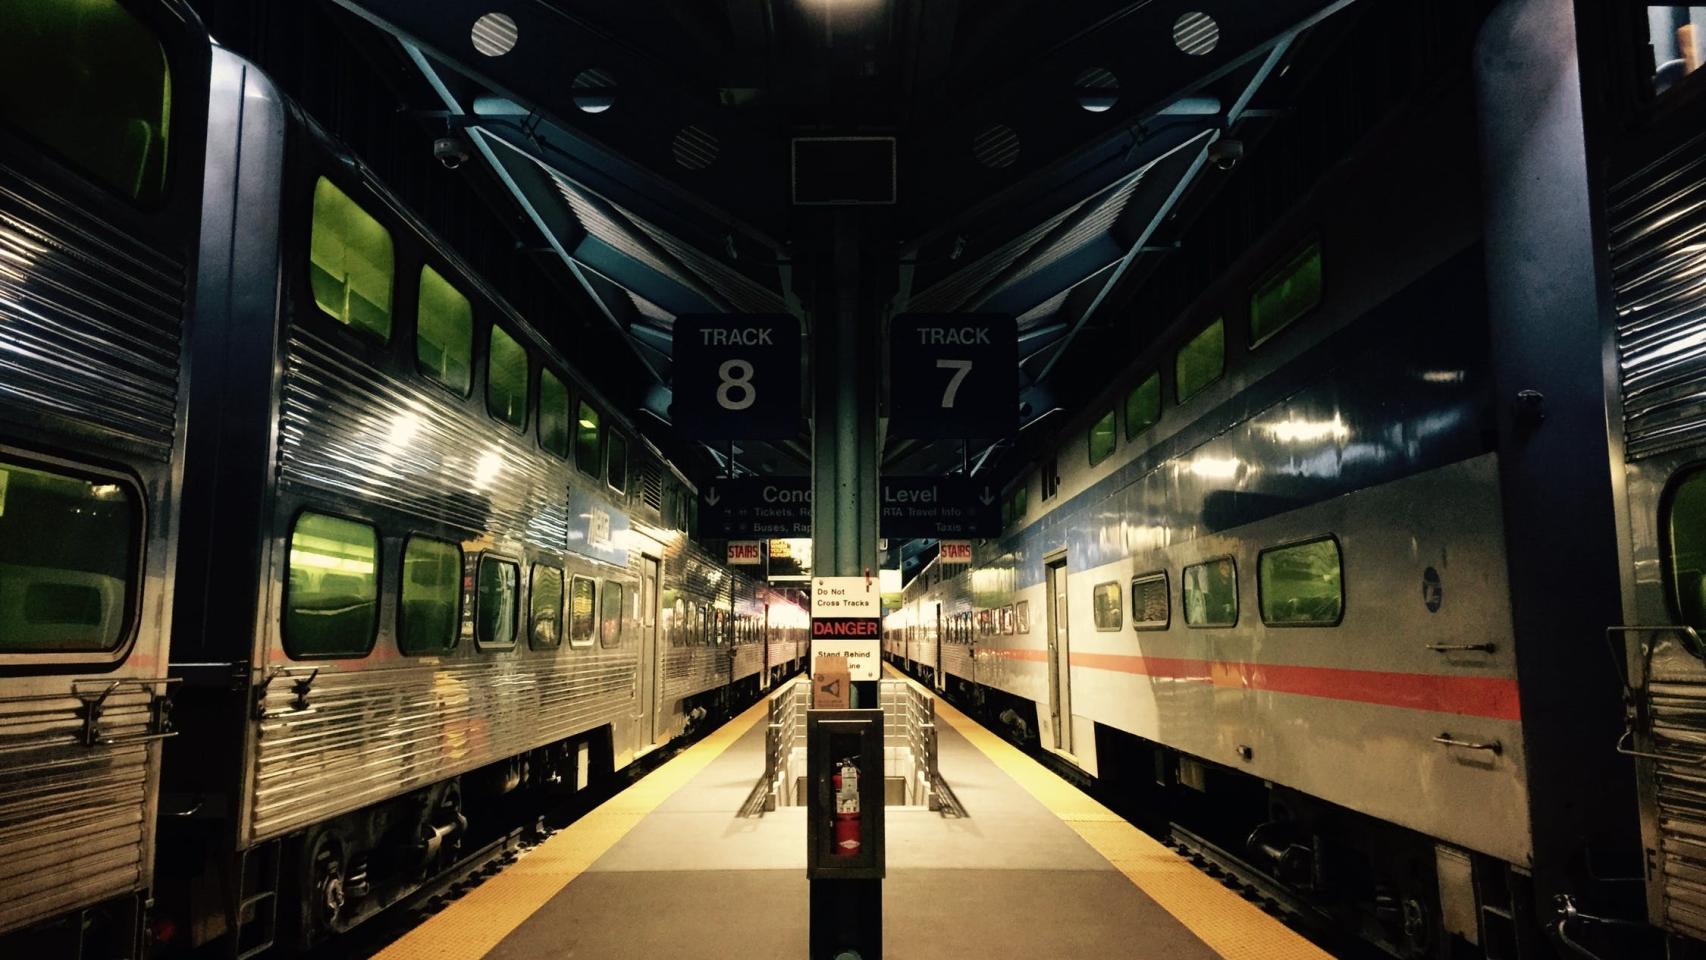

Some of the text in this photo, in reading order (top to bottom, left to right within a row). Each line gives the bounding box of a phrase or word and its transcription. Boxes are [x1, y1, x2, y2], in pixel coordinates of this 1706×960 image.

[700, 328, 773, 346] TRACK
[917, 327, 990, 345] TRACK
[716, 359, 756, 410] 8
[936, 359, 973, 408] 7
[885, 485, 937, 503] Level
[884, 507, 903, 517] RTA
[909, 507, 937, 517] Travel
[942, 506, 962, 517] Info
[936, 522, 962, 533] Taxis
[728, 545, 759, 559] STAIRS
[941, 544, 971, 558] STAIRS
[817, 588, 845, 596] Do Not
[814, 622, 878, 635] DANGER
